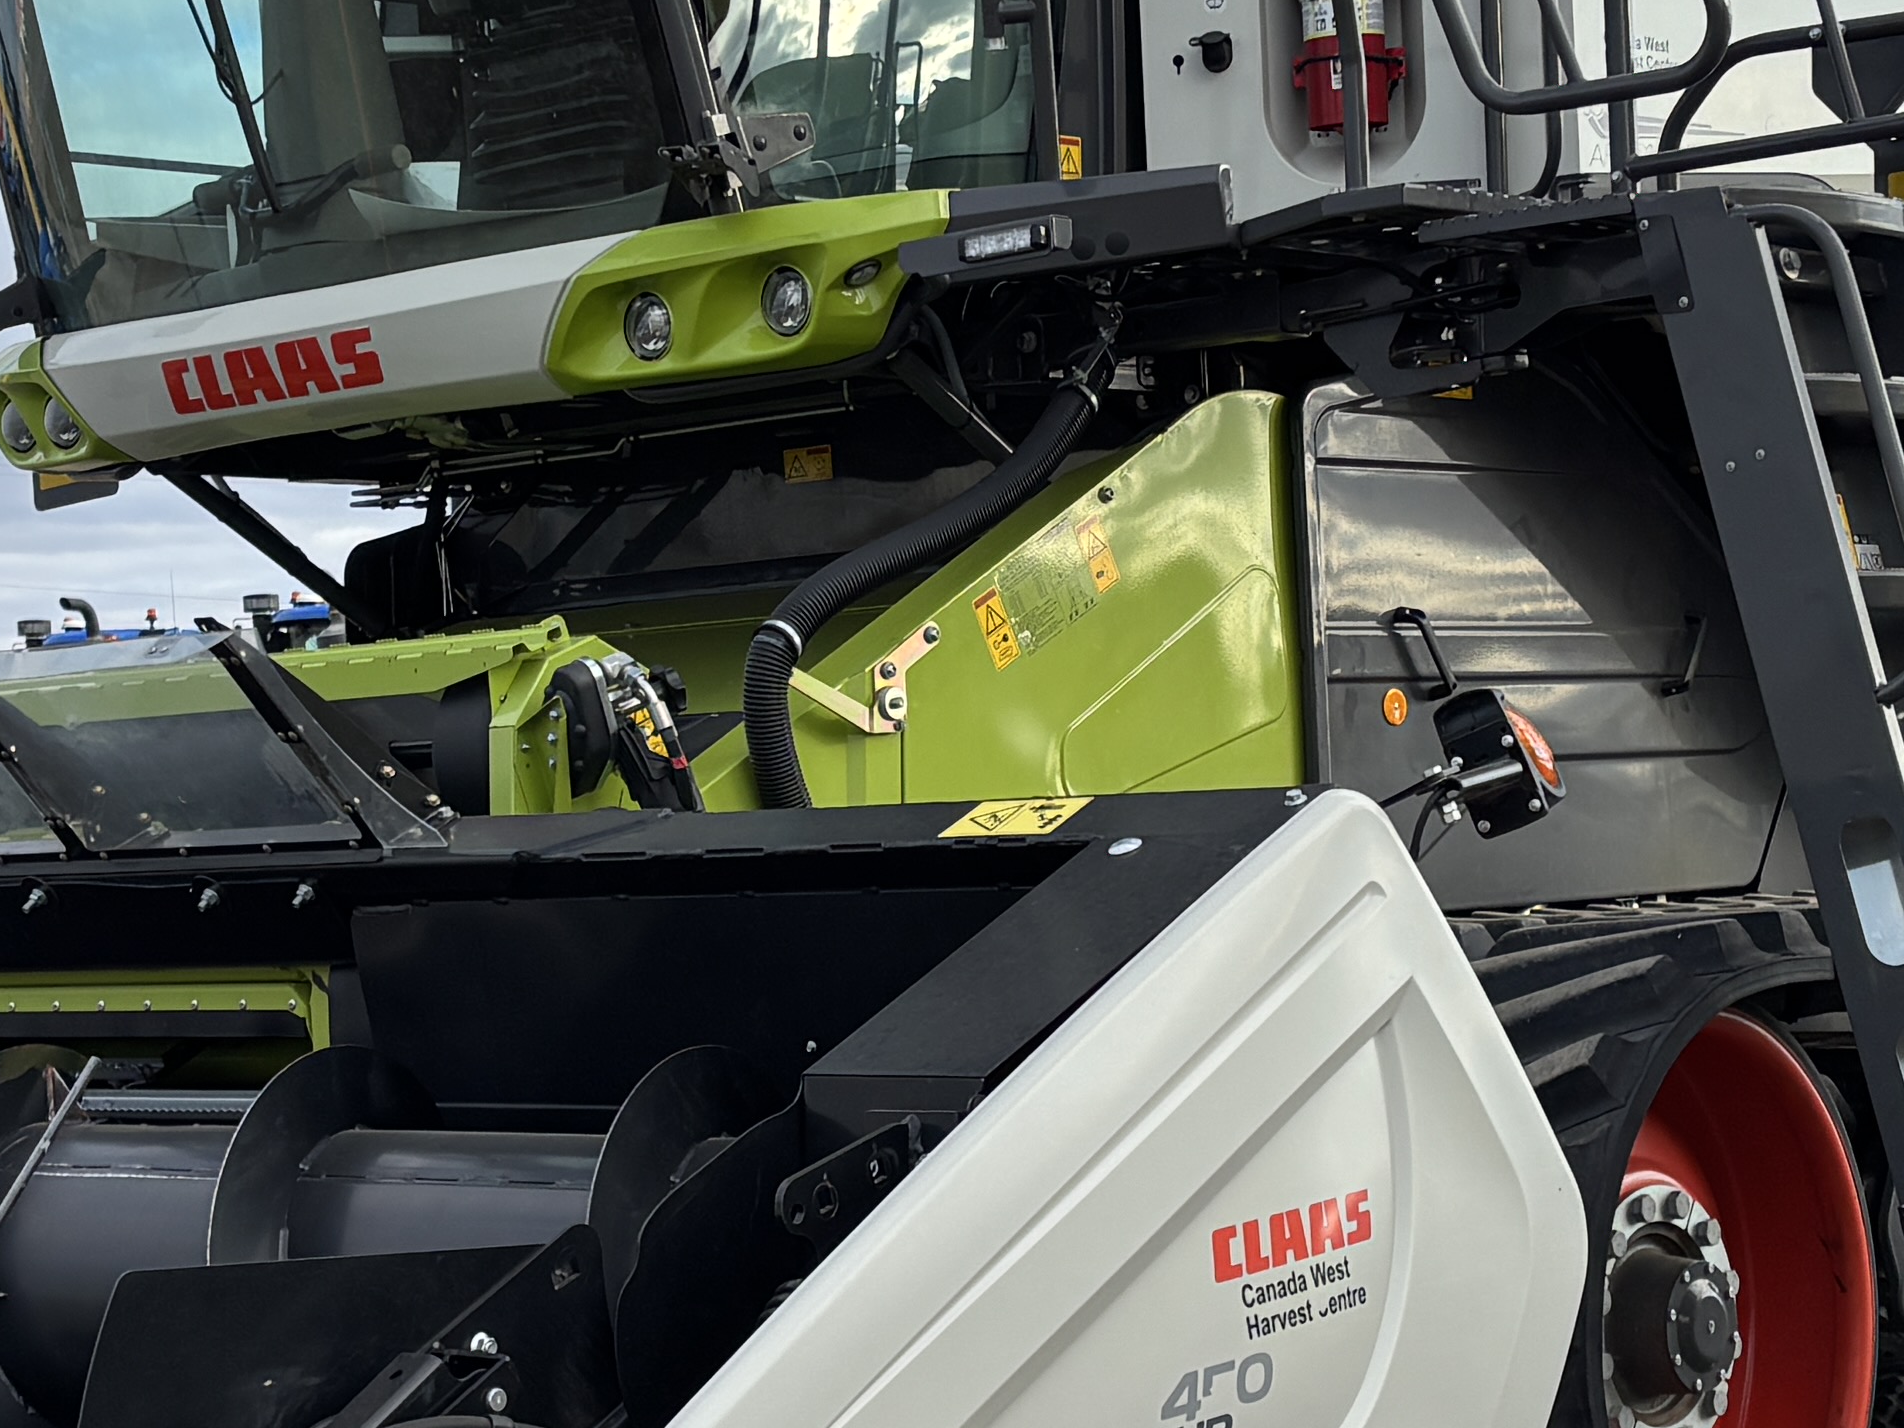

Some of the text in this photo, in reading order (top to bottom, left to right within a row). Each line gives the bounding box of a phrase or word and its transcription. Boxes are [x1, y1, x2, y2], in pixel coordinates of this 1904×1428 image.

[161, 326, 384, 415] CLAAS
[1211, 1188, 1372, 1283] CLAAS
[1241, 1255, 1351, 1309] Canada West
[1245, 1299, 1314, 1340] Harvest
